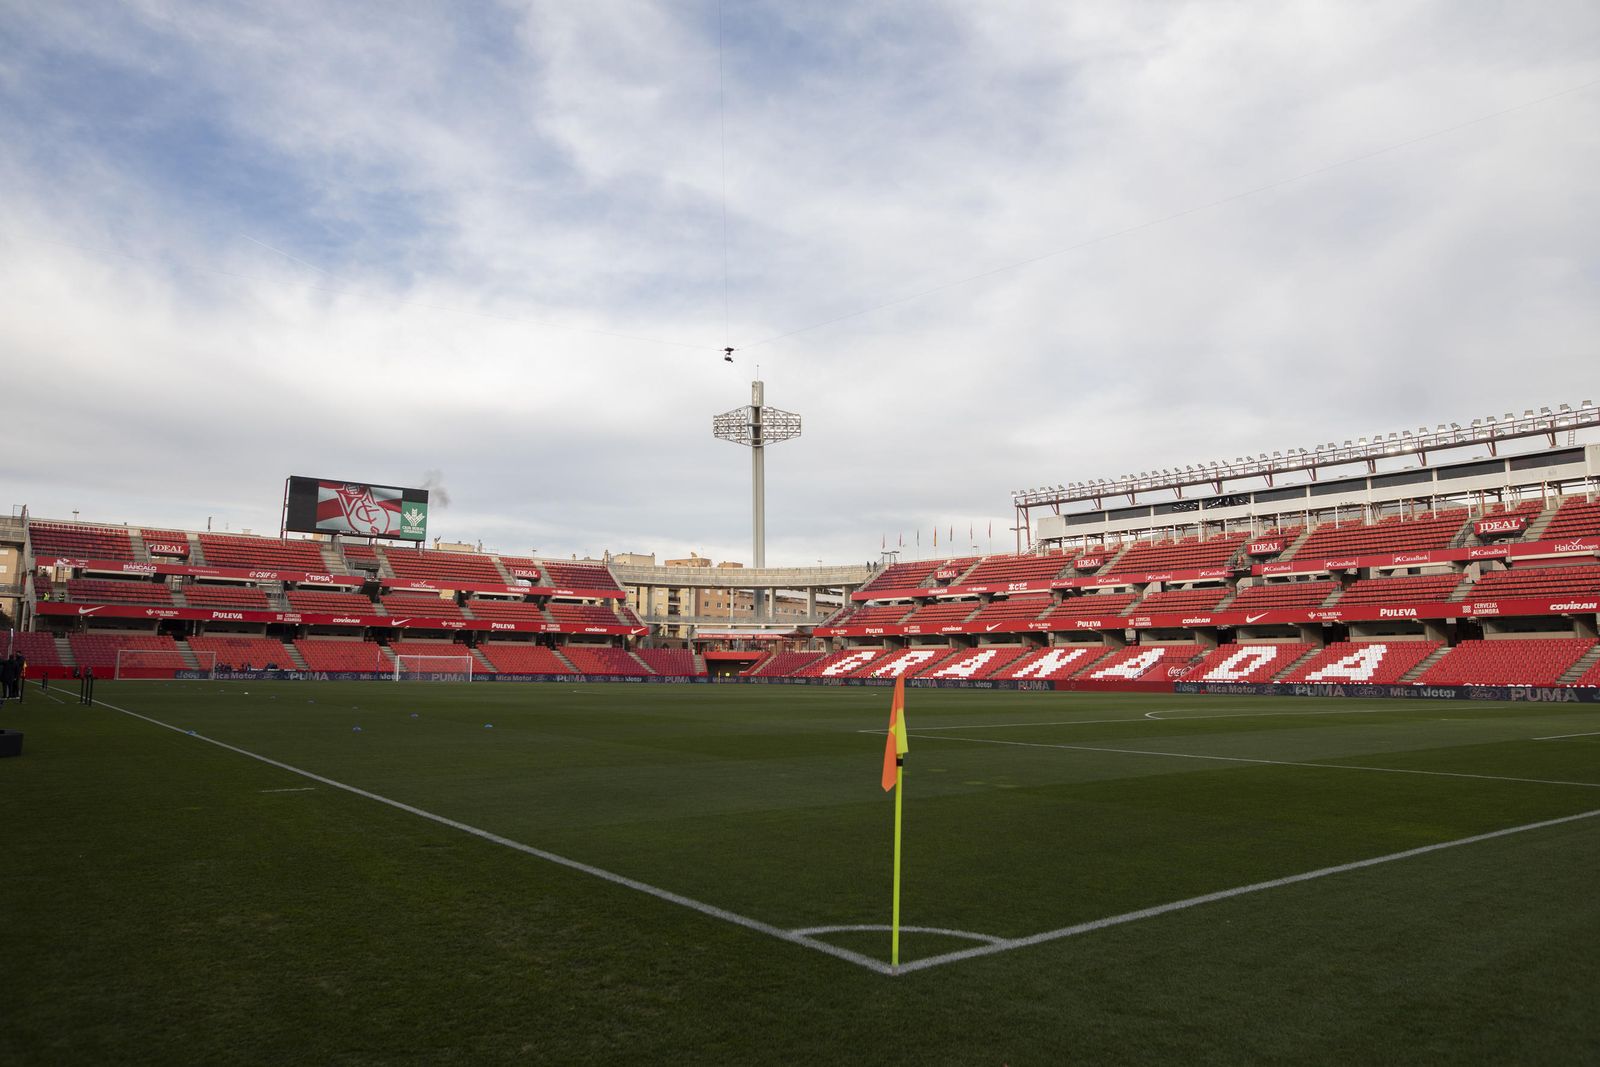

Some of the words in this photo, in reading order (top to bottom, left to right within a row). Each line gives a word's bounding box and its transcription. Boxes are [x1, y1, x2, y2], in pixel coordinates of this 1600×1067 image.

[1480, 521, 1519, 532] IDEAL
[152, 544, 184, 554] IDEAL
[1251, 543, 1280, 552] IDEAL
[1076, 559, 1100, 567] IDEAL
[514, 570, 537, 578] IDEAL
[937, 570, 956, 578] IDEAL
[212, 611, 243, 620] PULEVA
[1380, 608, 1417, 617] PULEVA
[432, 673, 465, 681] PUMA
[1018, 681, 1050, 690] PUMA
[1206, 685, 1227, 693] Mica
[1229, 685, 1256, 694] Motor
[1390, 687, 1418, 697] Mica
[1511, 687, 1580, 702] PUMA
